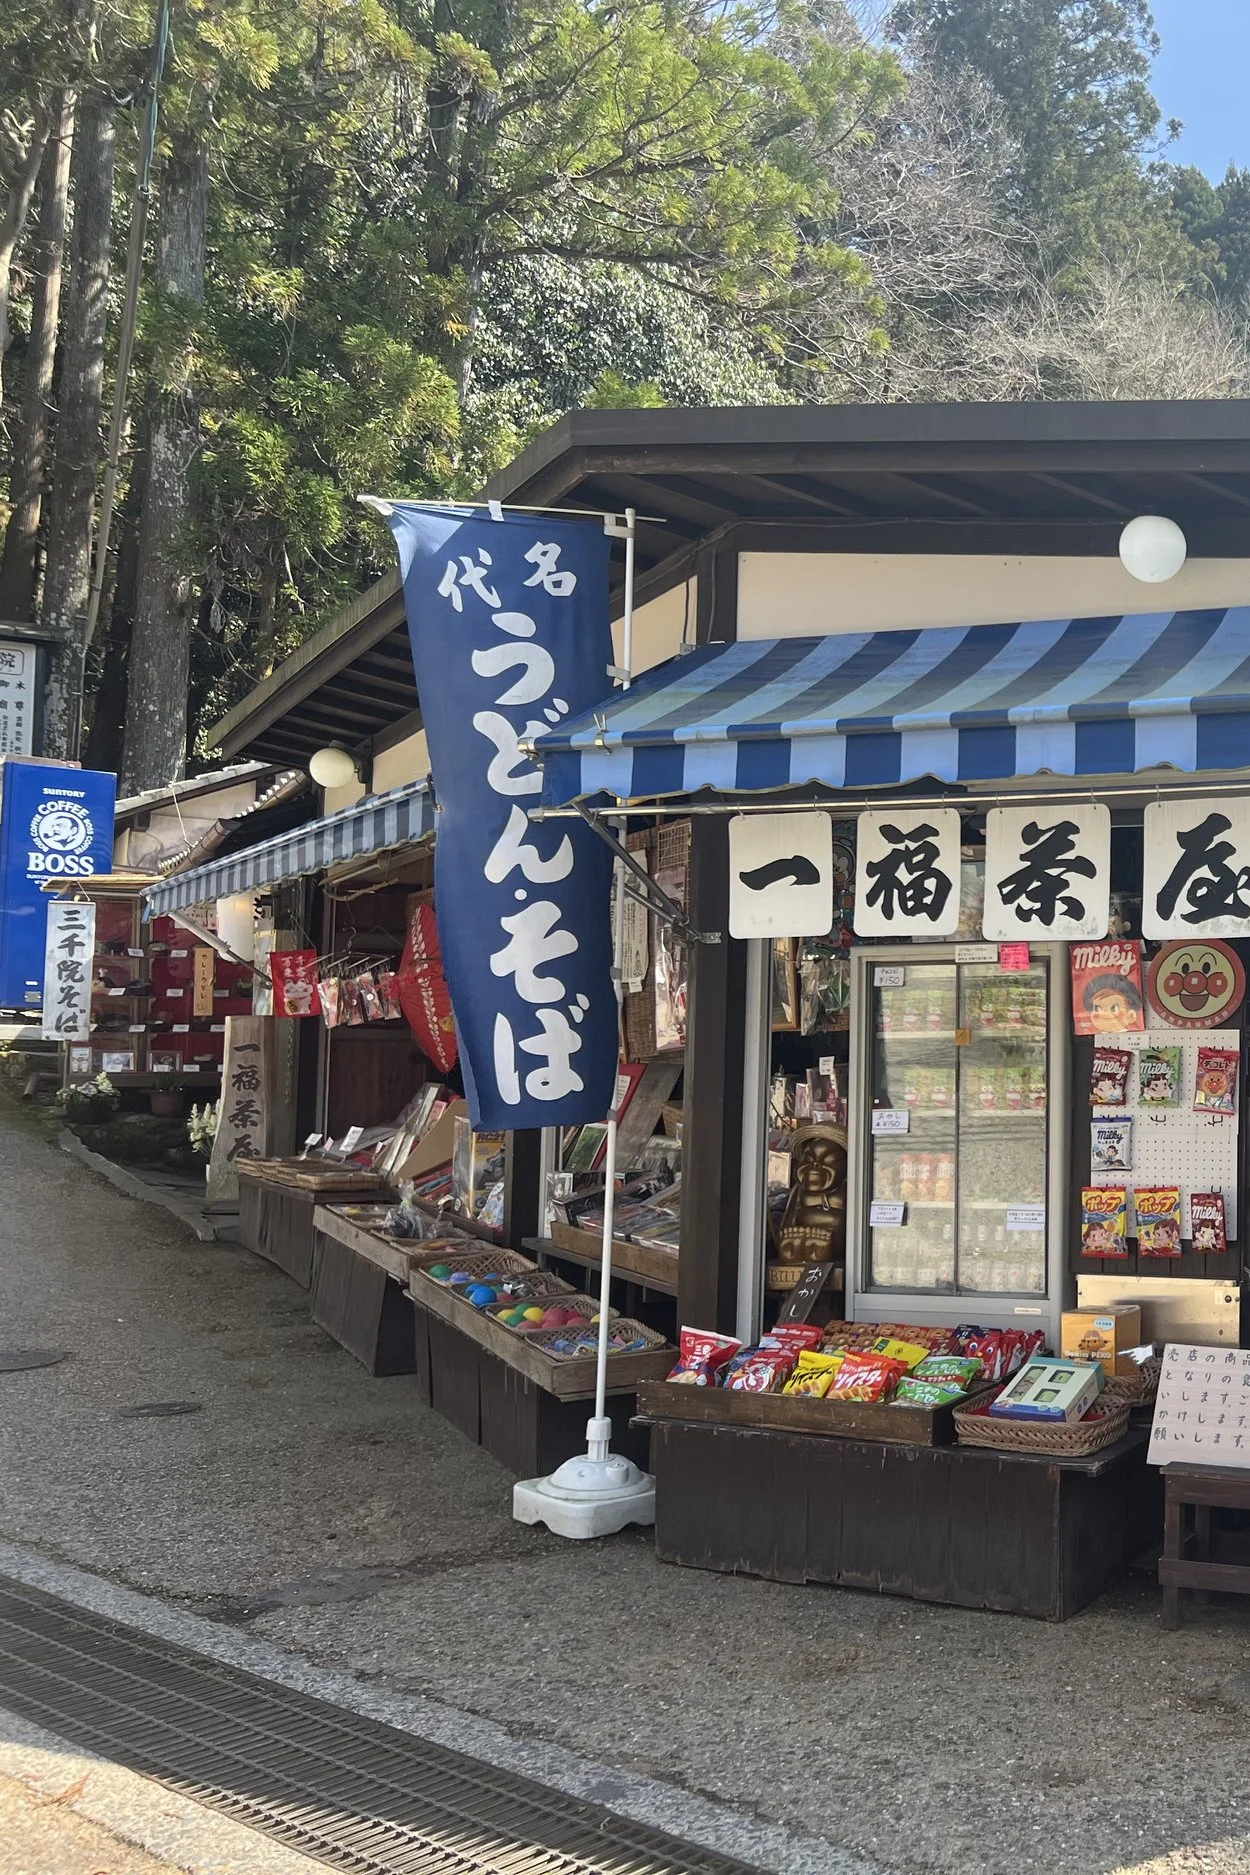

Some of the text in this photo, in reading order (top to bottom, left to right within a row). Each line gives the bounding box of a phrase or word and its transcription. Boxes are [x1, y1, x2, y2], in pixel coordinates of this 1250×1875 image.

[38, 801, 89, 818] COFFEE
[27, 852, 94, 875] BOSS
[1073, 945, 1136, 975] Milky
[54, 910, 87, 1033] 三千院そば
[1092, 1060, 1127, 1079] Milky
[1140, 1063, 1175, 1079] Milky
[227, 1043, 261, 1162] 一福茶屋
[1097, 1130, 1124, 1143] Milky
[1086, 1195, 1122, 1214] ポップ
[1139, 1195, 1176, 1214] ポップ
[1192, 1205, 1223, 1226] Milky
[789, 1267, 822, 1318] おかし
